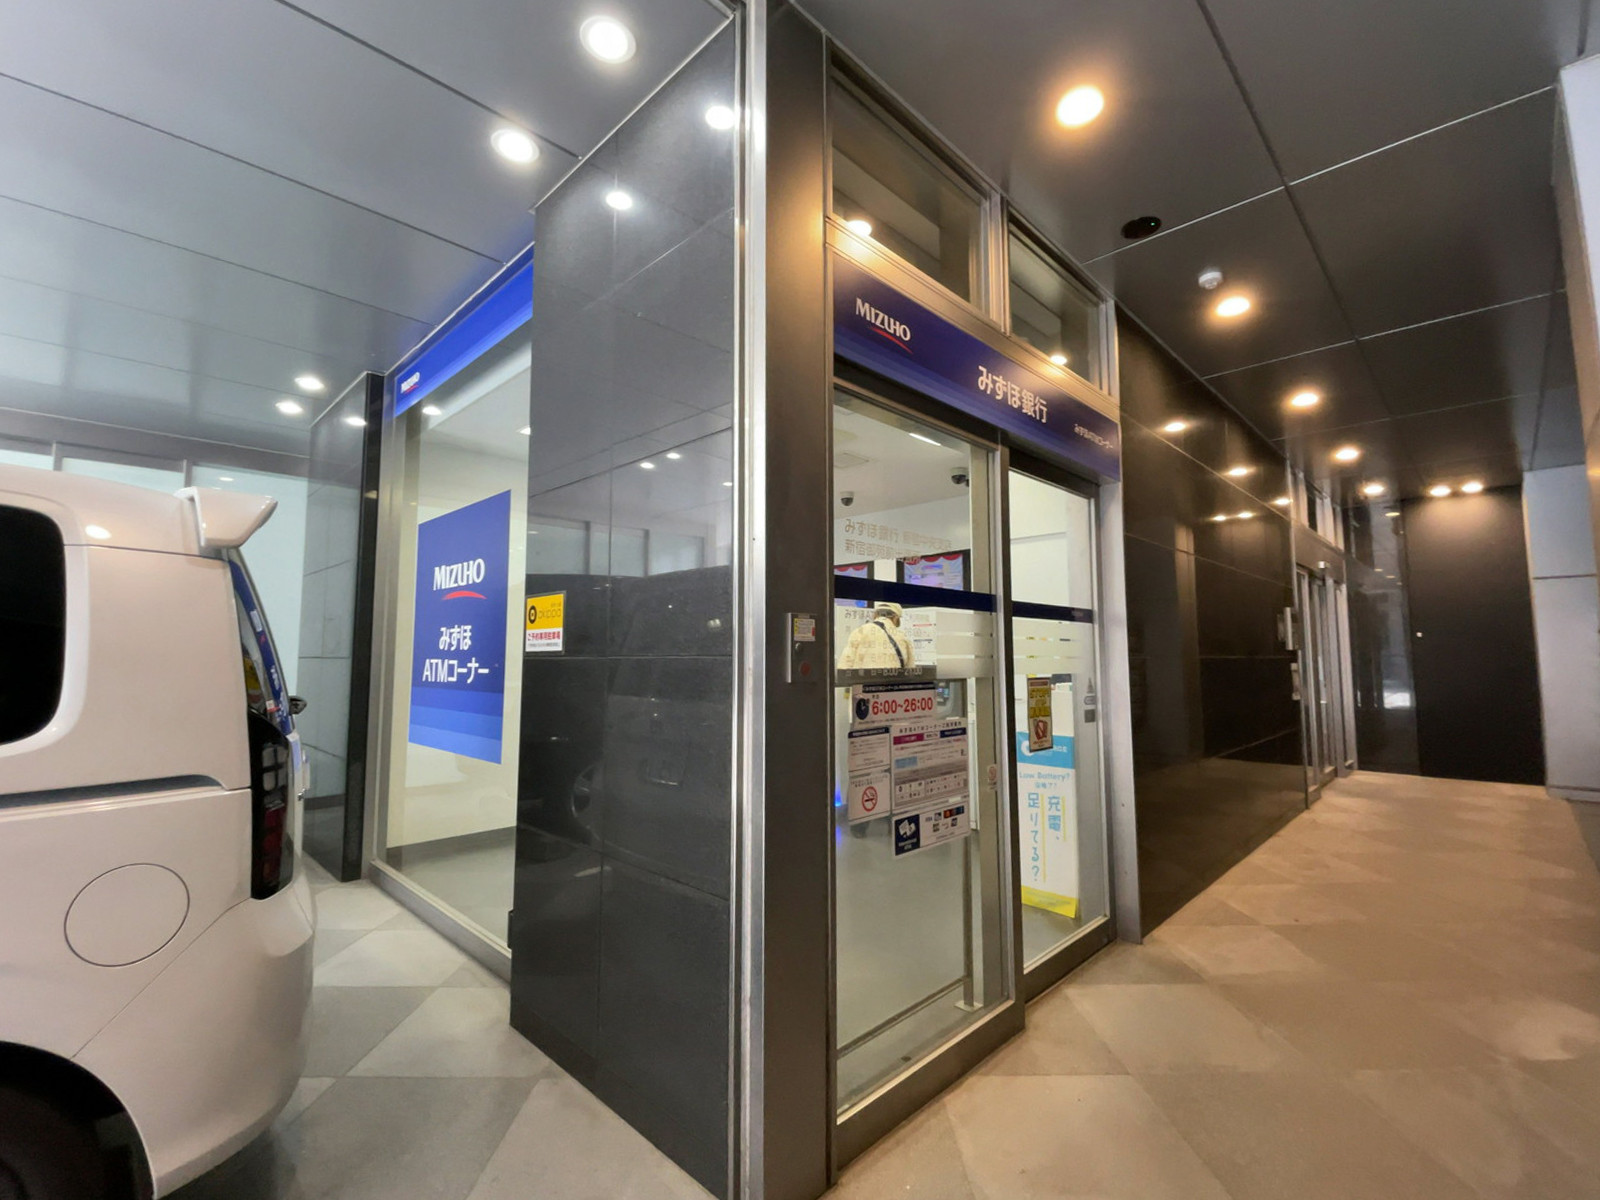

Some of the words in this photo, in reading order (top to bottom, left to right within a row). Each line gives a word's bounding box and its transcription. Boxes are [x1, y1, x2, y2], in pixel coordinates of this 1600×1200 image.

[856, 297, 912, 342] MIZUHO
[978, 365, 1048, 424] みずほ銀行
[433, 558, 486, 592] MIZUHO
[438, 624, 472, 652] みずほ
[422, 657, 490, 684] ATMコーナー
[1019, 771, 1035, 779] Low
[1037, 771, 1071, 783] Battery?
